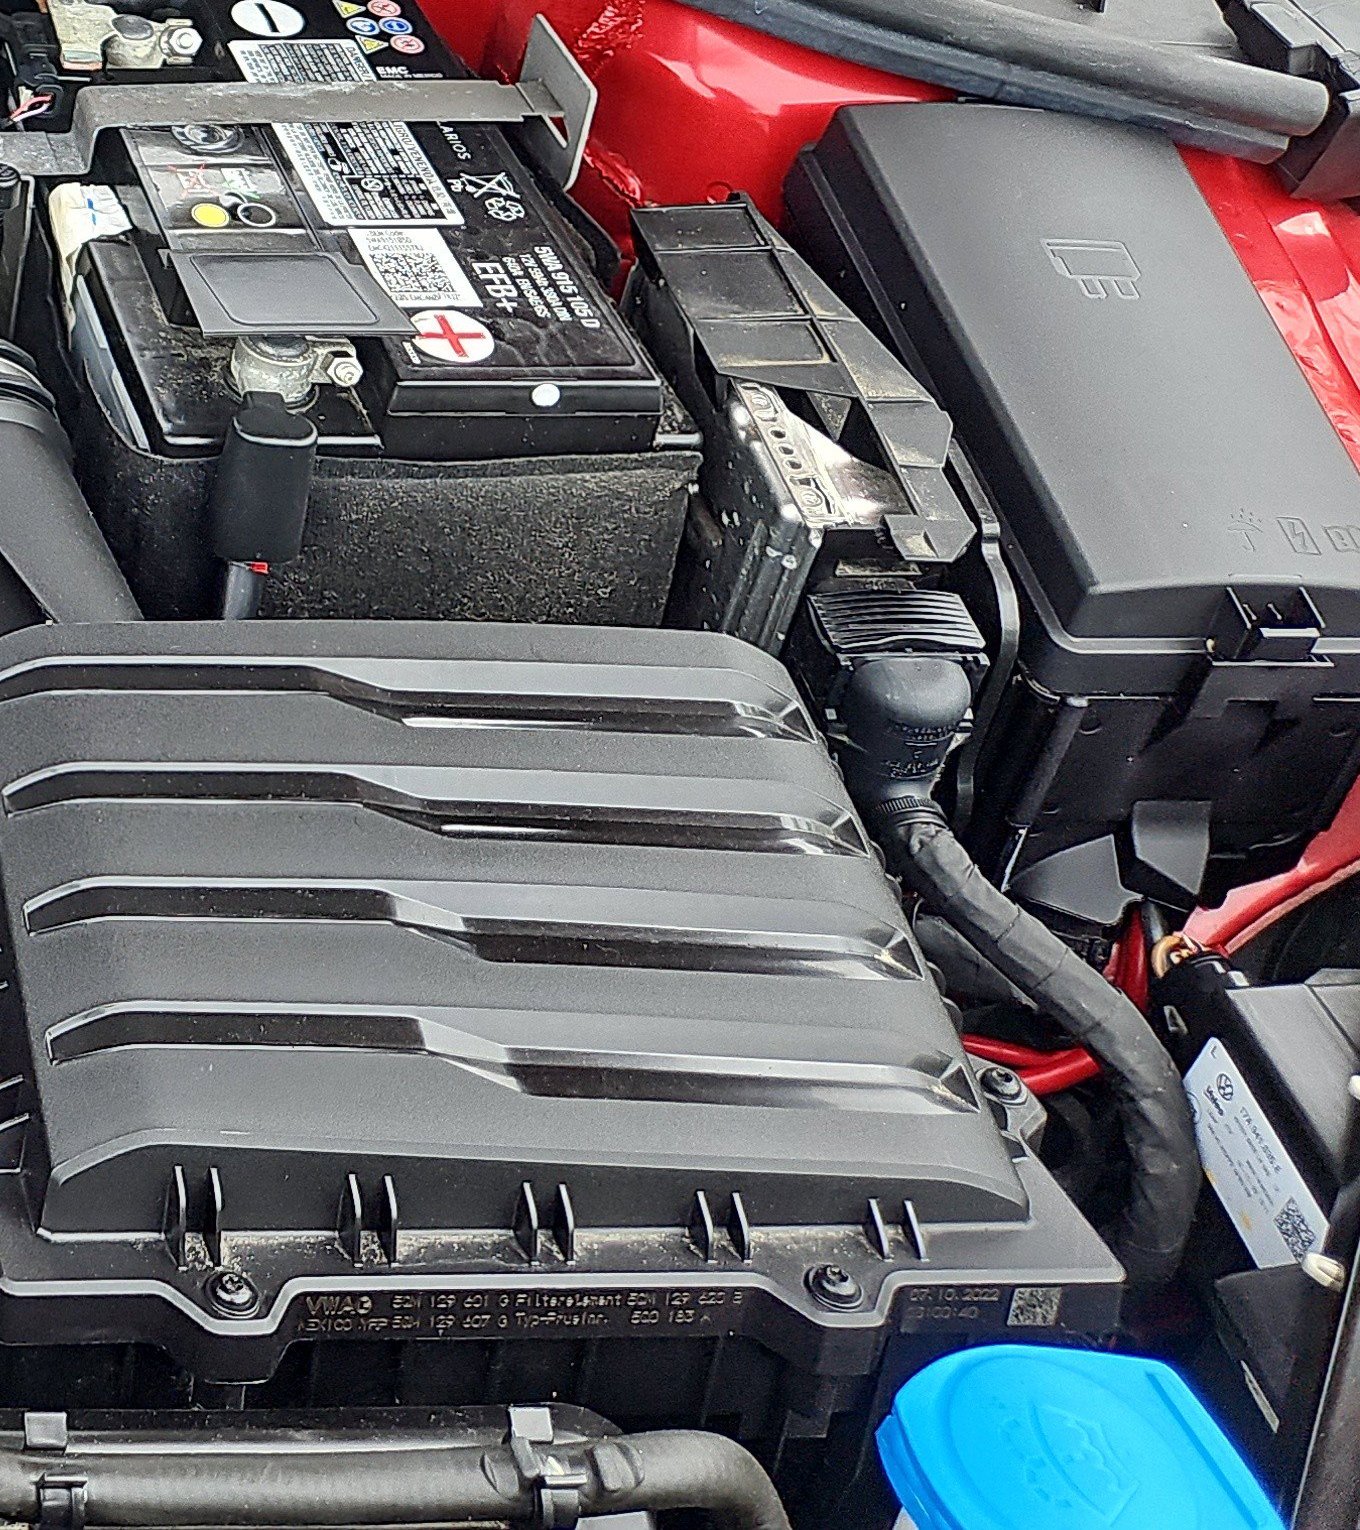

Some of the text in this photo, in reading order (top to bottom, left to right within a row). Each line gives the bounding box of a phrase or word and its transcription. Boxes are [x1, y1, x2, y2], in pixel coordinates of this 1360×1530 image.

[376, 66, 409, 75] EMC
[472, 262, 518, 314] EFB+
[534, 246, 601, 329] 5WA 915 105 D
[306, 1295, 374, 1316] VWAG
[431, 1294, 456, 1309] 129
[463, 1294, 489, 1308] 601
[665, 1292, 691, 1306] 129
[430, 1315, 456, 1329] 129
[462, 1314, 491, 1329] 607
